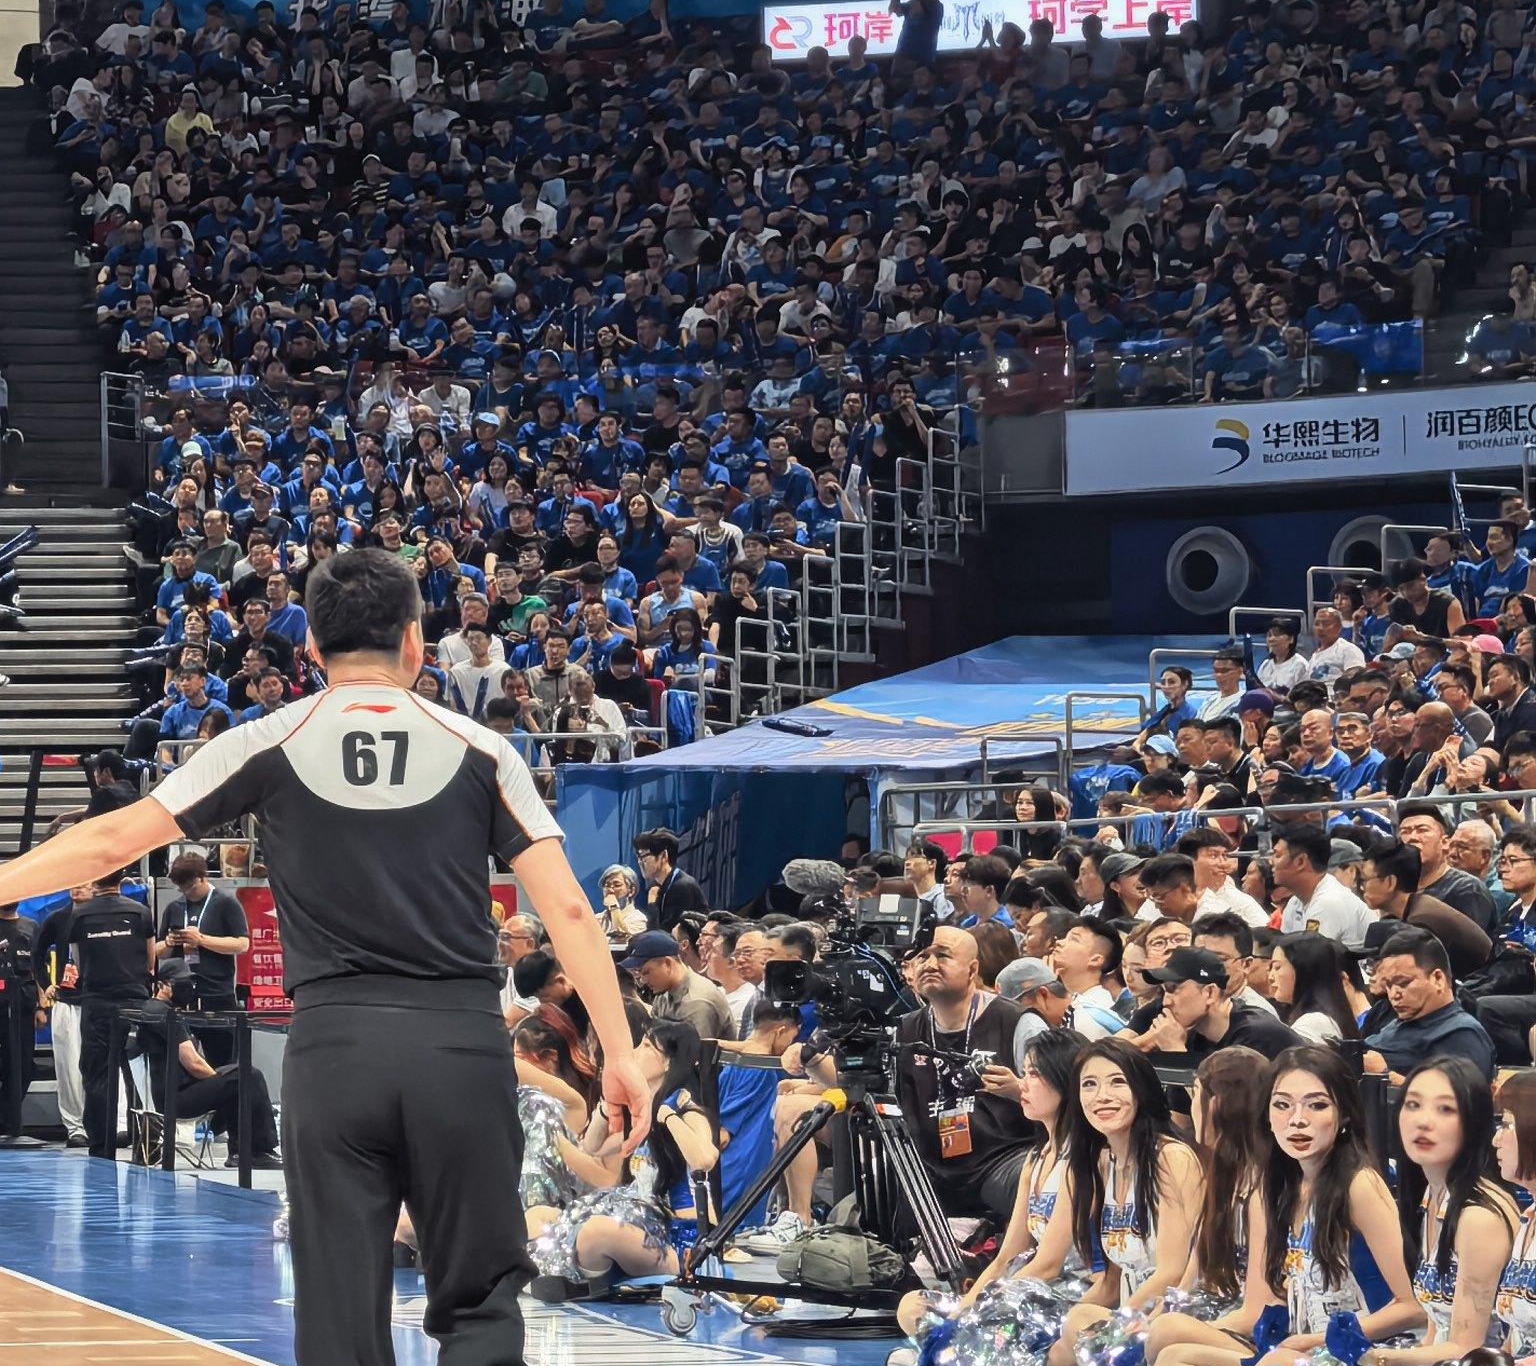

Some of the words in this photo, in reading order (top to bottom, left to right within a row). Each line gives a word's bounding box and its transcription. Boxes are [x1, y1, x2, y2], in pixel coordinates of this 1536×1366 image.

[824, 10, 894, 47] 珂岸
[1262, 417, 1380, 449] 华熙生物
[342, 730, 409, 786] 67
